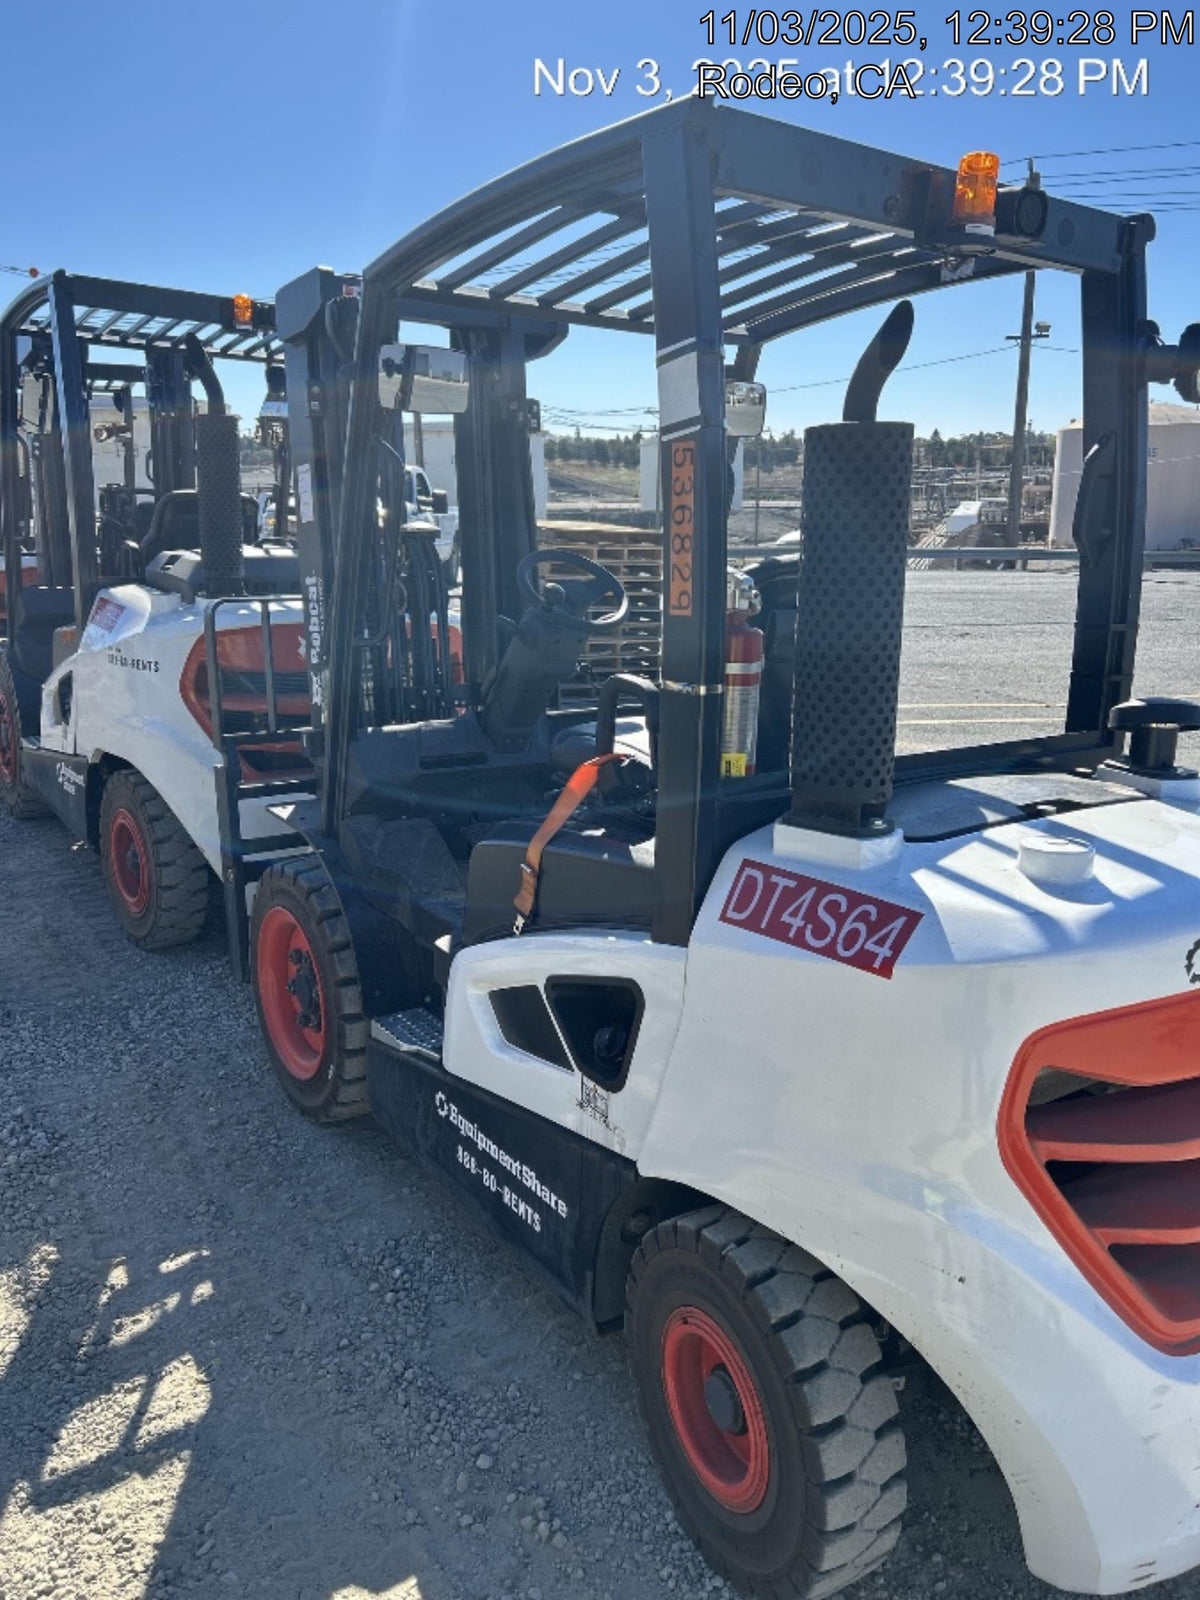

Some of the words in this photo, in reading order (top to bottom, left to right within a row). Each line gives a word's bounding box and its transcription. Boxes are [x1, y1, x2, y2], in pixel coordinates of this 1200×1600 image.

[672, 447, 694, 611] 536829
[726, 866, 908, 970] DT4S64
[449, 1102, 569, 1219] EquipmentShare
